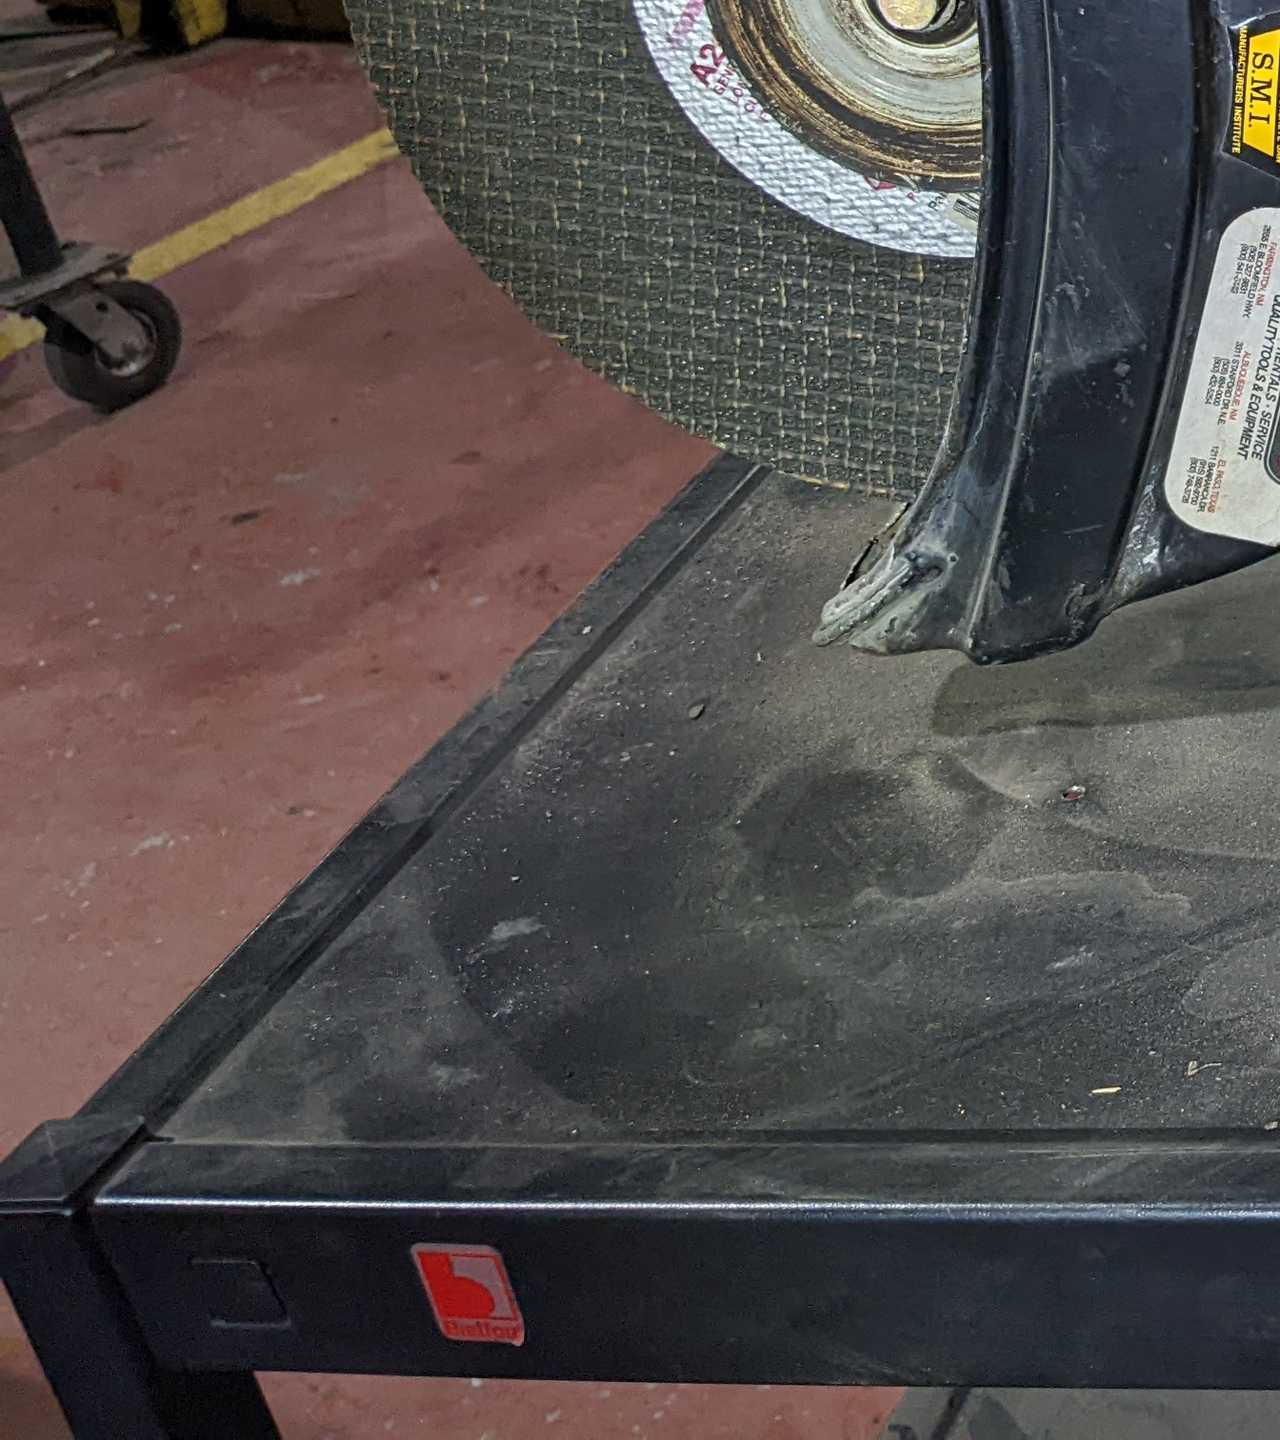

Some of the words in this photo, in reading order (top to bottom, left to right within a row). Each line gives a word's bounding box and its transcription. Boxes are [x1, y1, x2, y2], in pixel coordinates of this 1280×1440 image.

[1234, 25, 1248, 108] MANUFACTURERS
[1248, 51, 1274, 128] S.M.I.
[1231, 108, 1243, 154] INSTITUTE
[1254, 338, 1275, 382] TOOLS
[1252, 383, 1263, 392] &
[1236, 393, 1262, 461] EQUIPMENT
[1250, 409, 1273, 461] SERVICE
